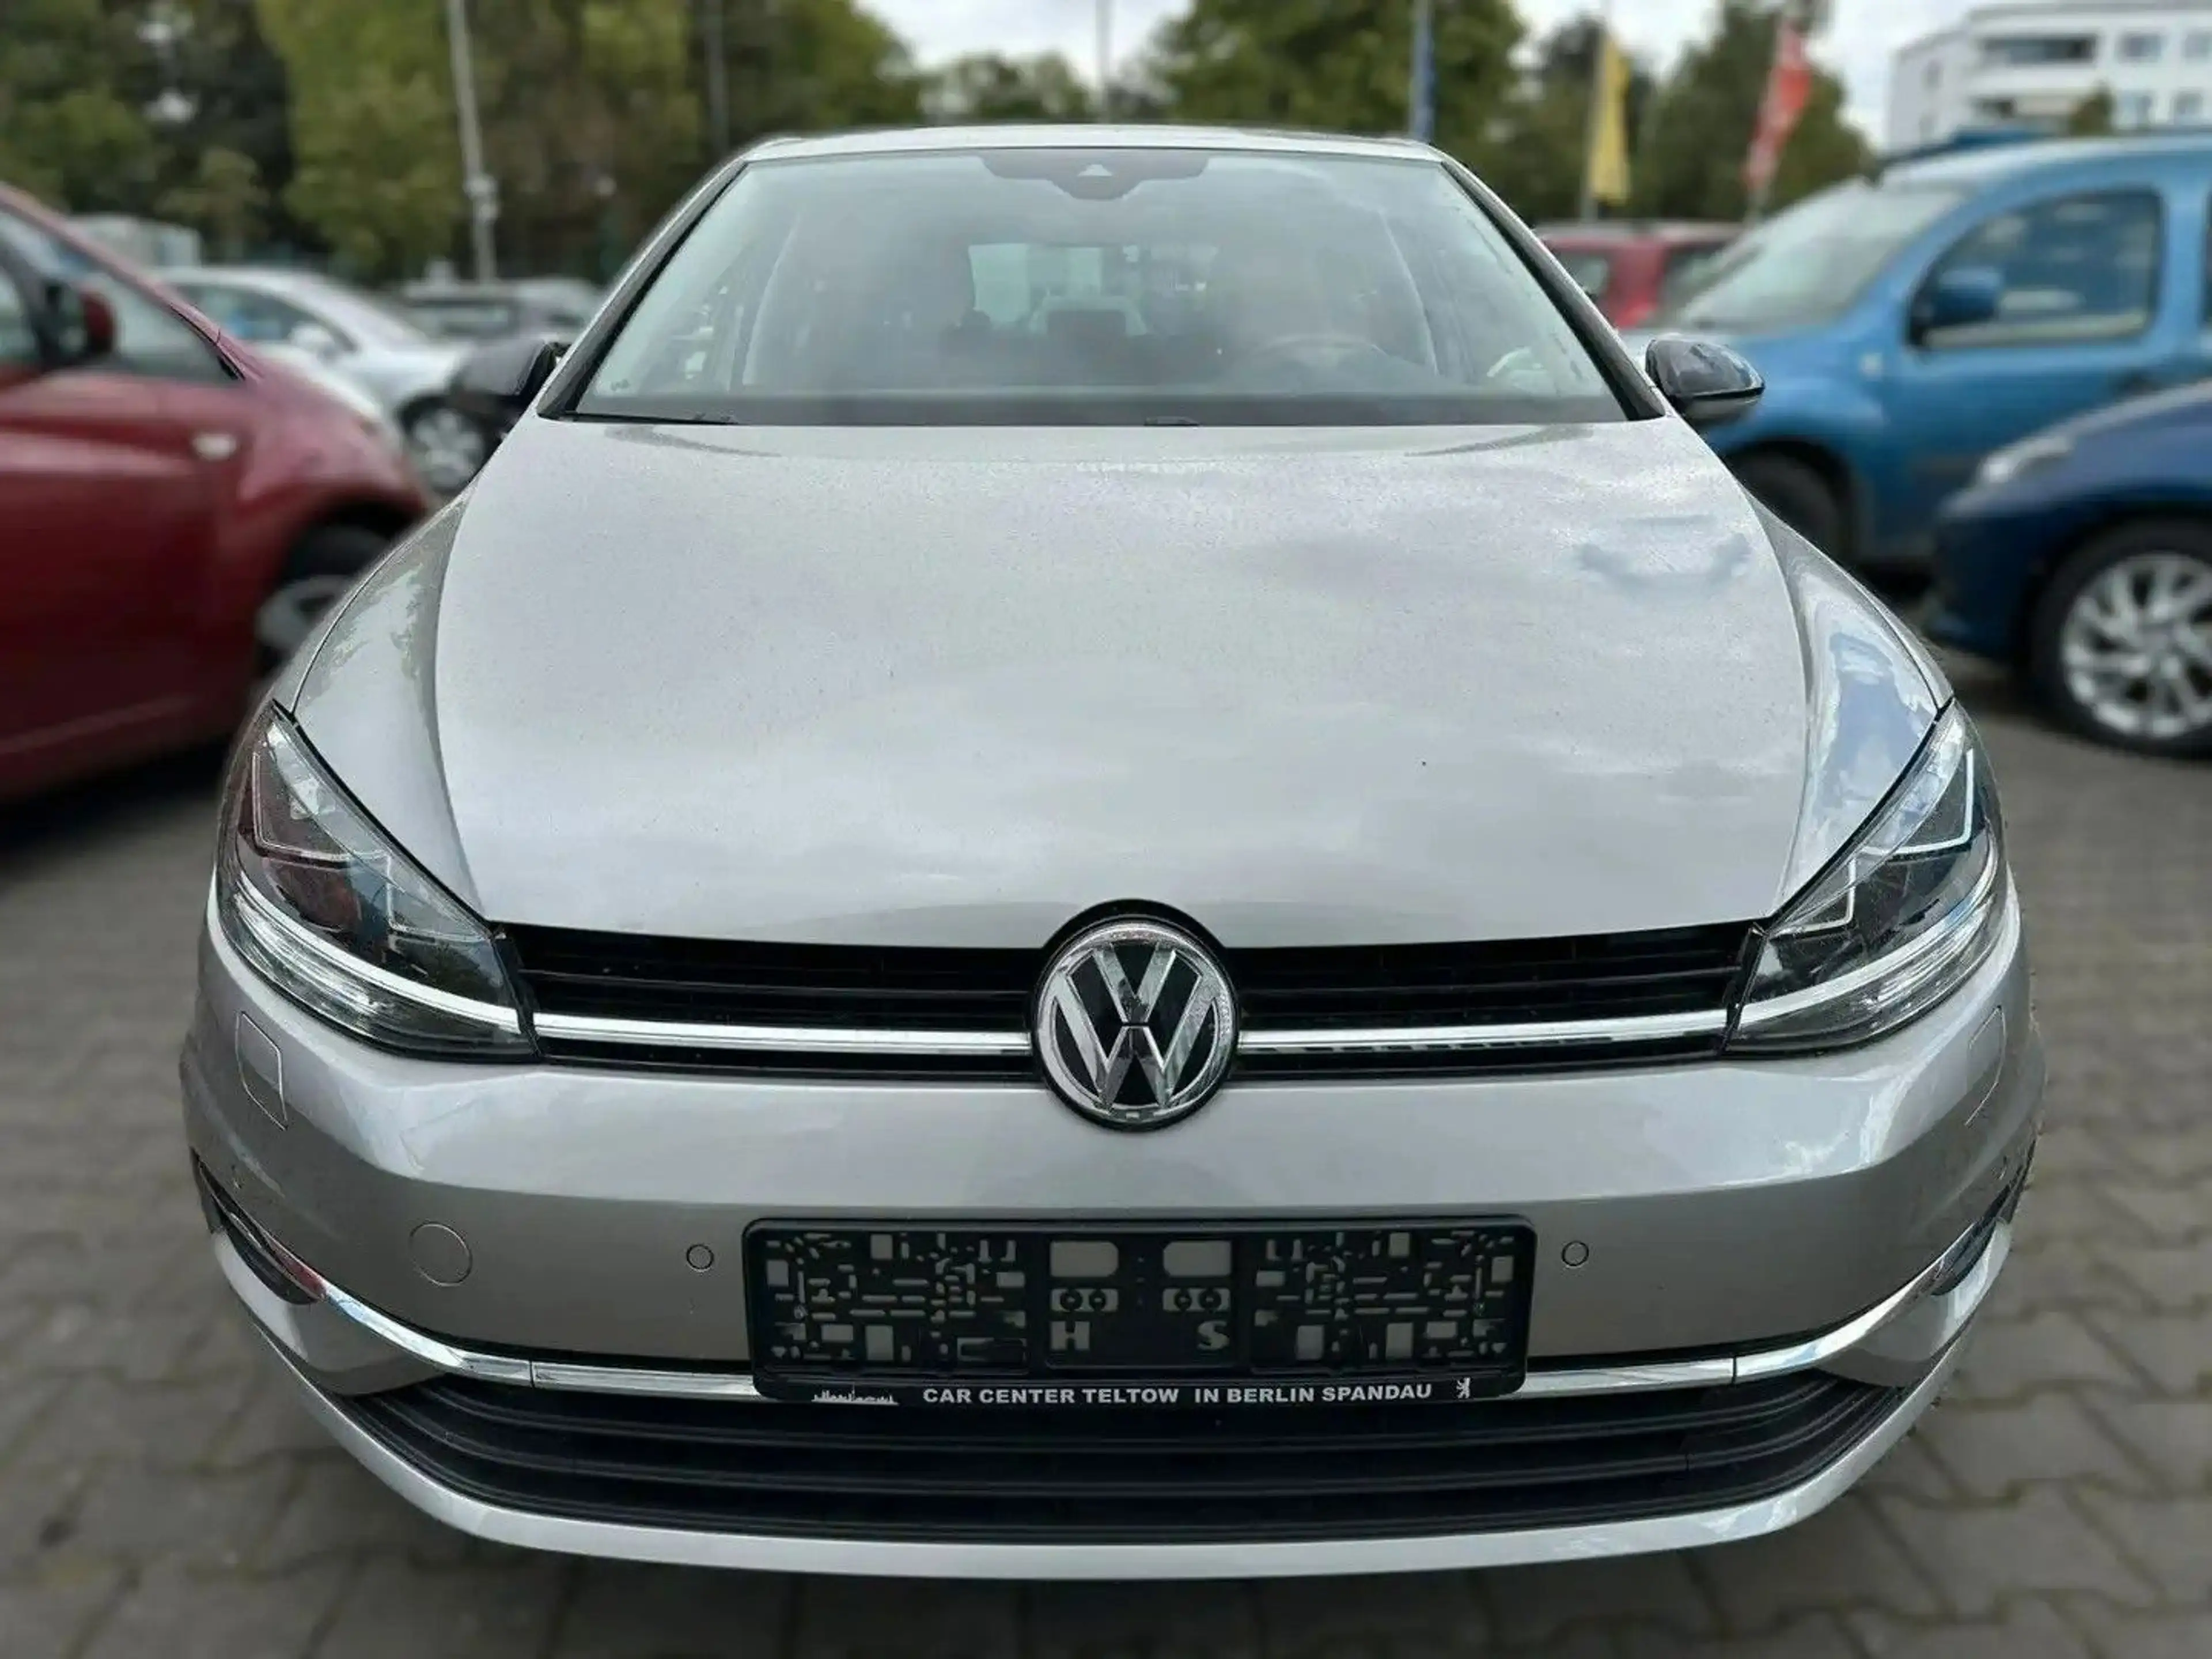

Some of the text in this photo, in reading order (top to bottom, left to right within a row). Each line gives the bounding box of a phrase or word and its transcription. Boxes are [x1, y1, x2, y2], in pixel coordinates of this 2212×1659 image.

[1050, 940, 1219, 1109] VW
[1050, 1320, 1090, 1350] H
[1197, 1320, 1230, 1350] S
[922, 1383, 1432, 1404] CAR CENTER TELTOW IN BERLIN SPANDAU
